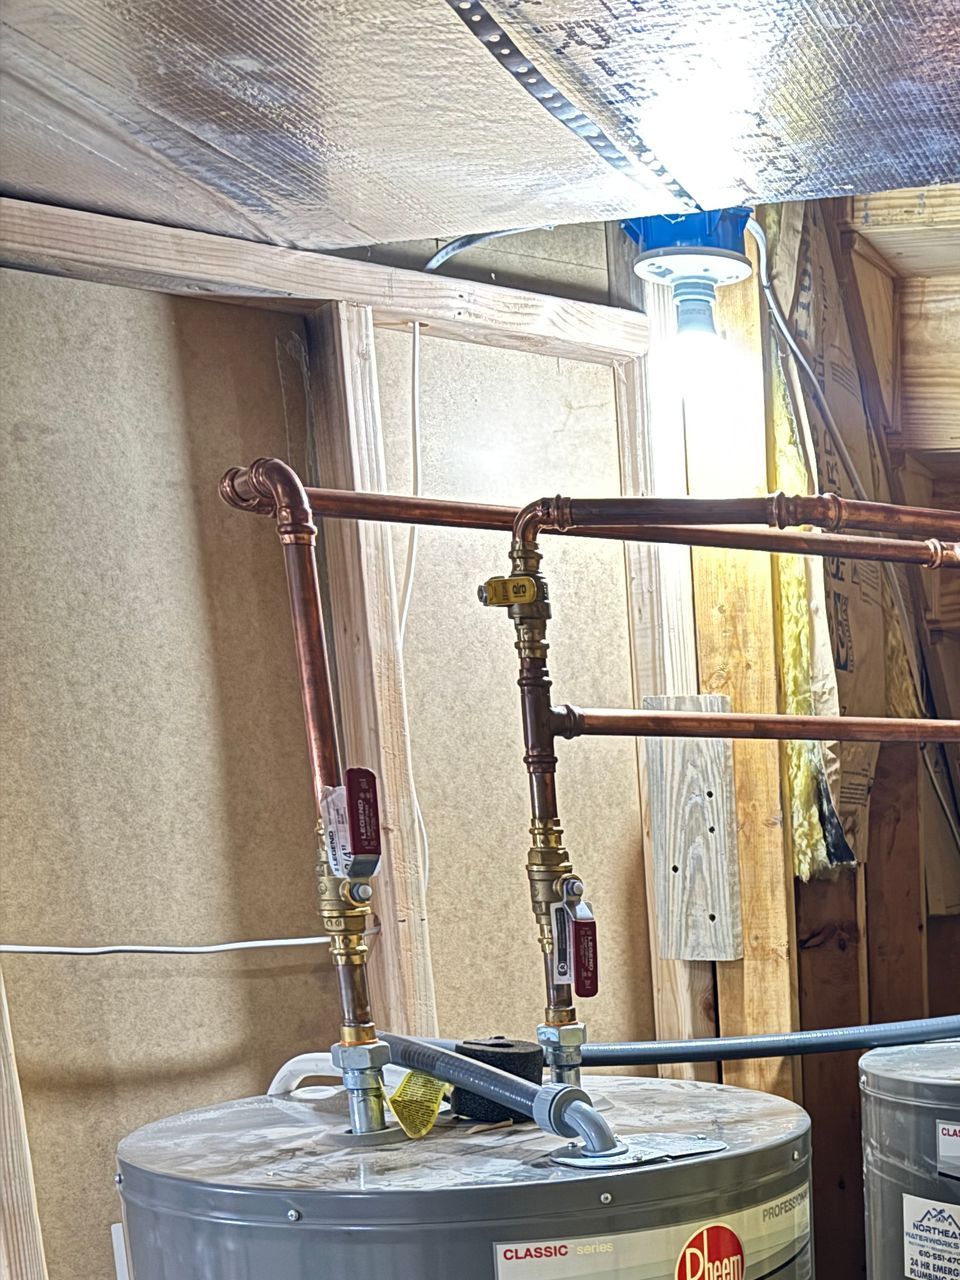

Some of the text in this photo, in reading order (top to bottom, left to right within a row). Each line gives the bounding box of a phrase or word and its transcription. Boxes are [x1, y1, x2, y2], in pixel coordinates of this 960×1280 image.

[357, 799, 368, 840] LEGEND
[327, 830, 340, 867] LEGEND
[905, 1231, 960, 1250] WATERWORKS
[503, 1241, 614, 1261] CLASSIC series
[910, 1257, 919, 1267] 24
[920, 1259, 931, 1270] HR
